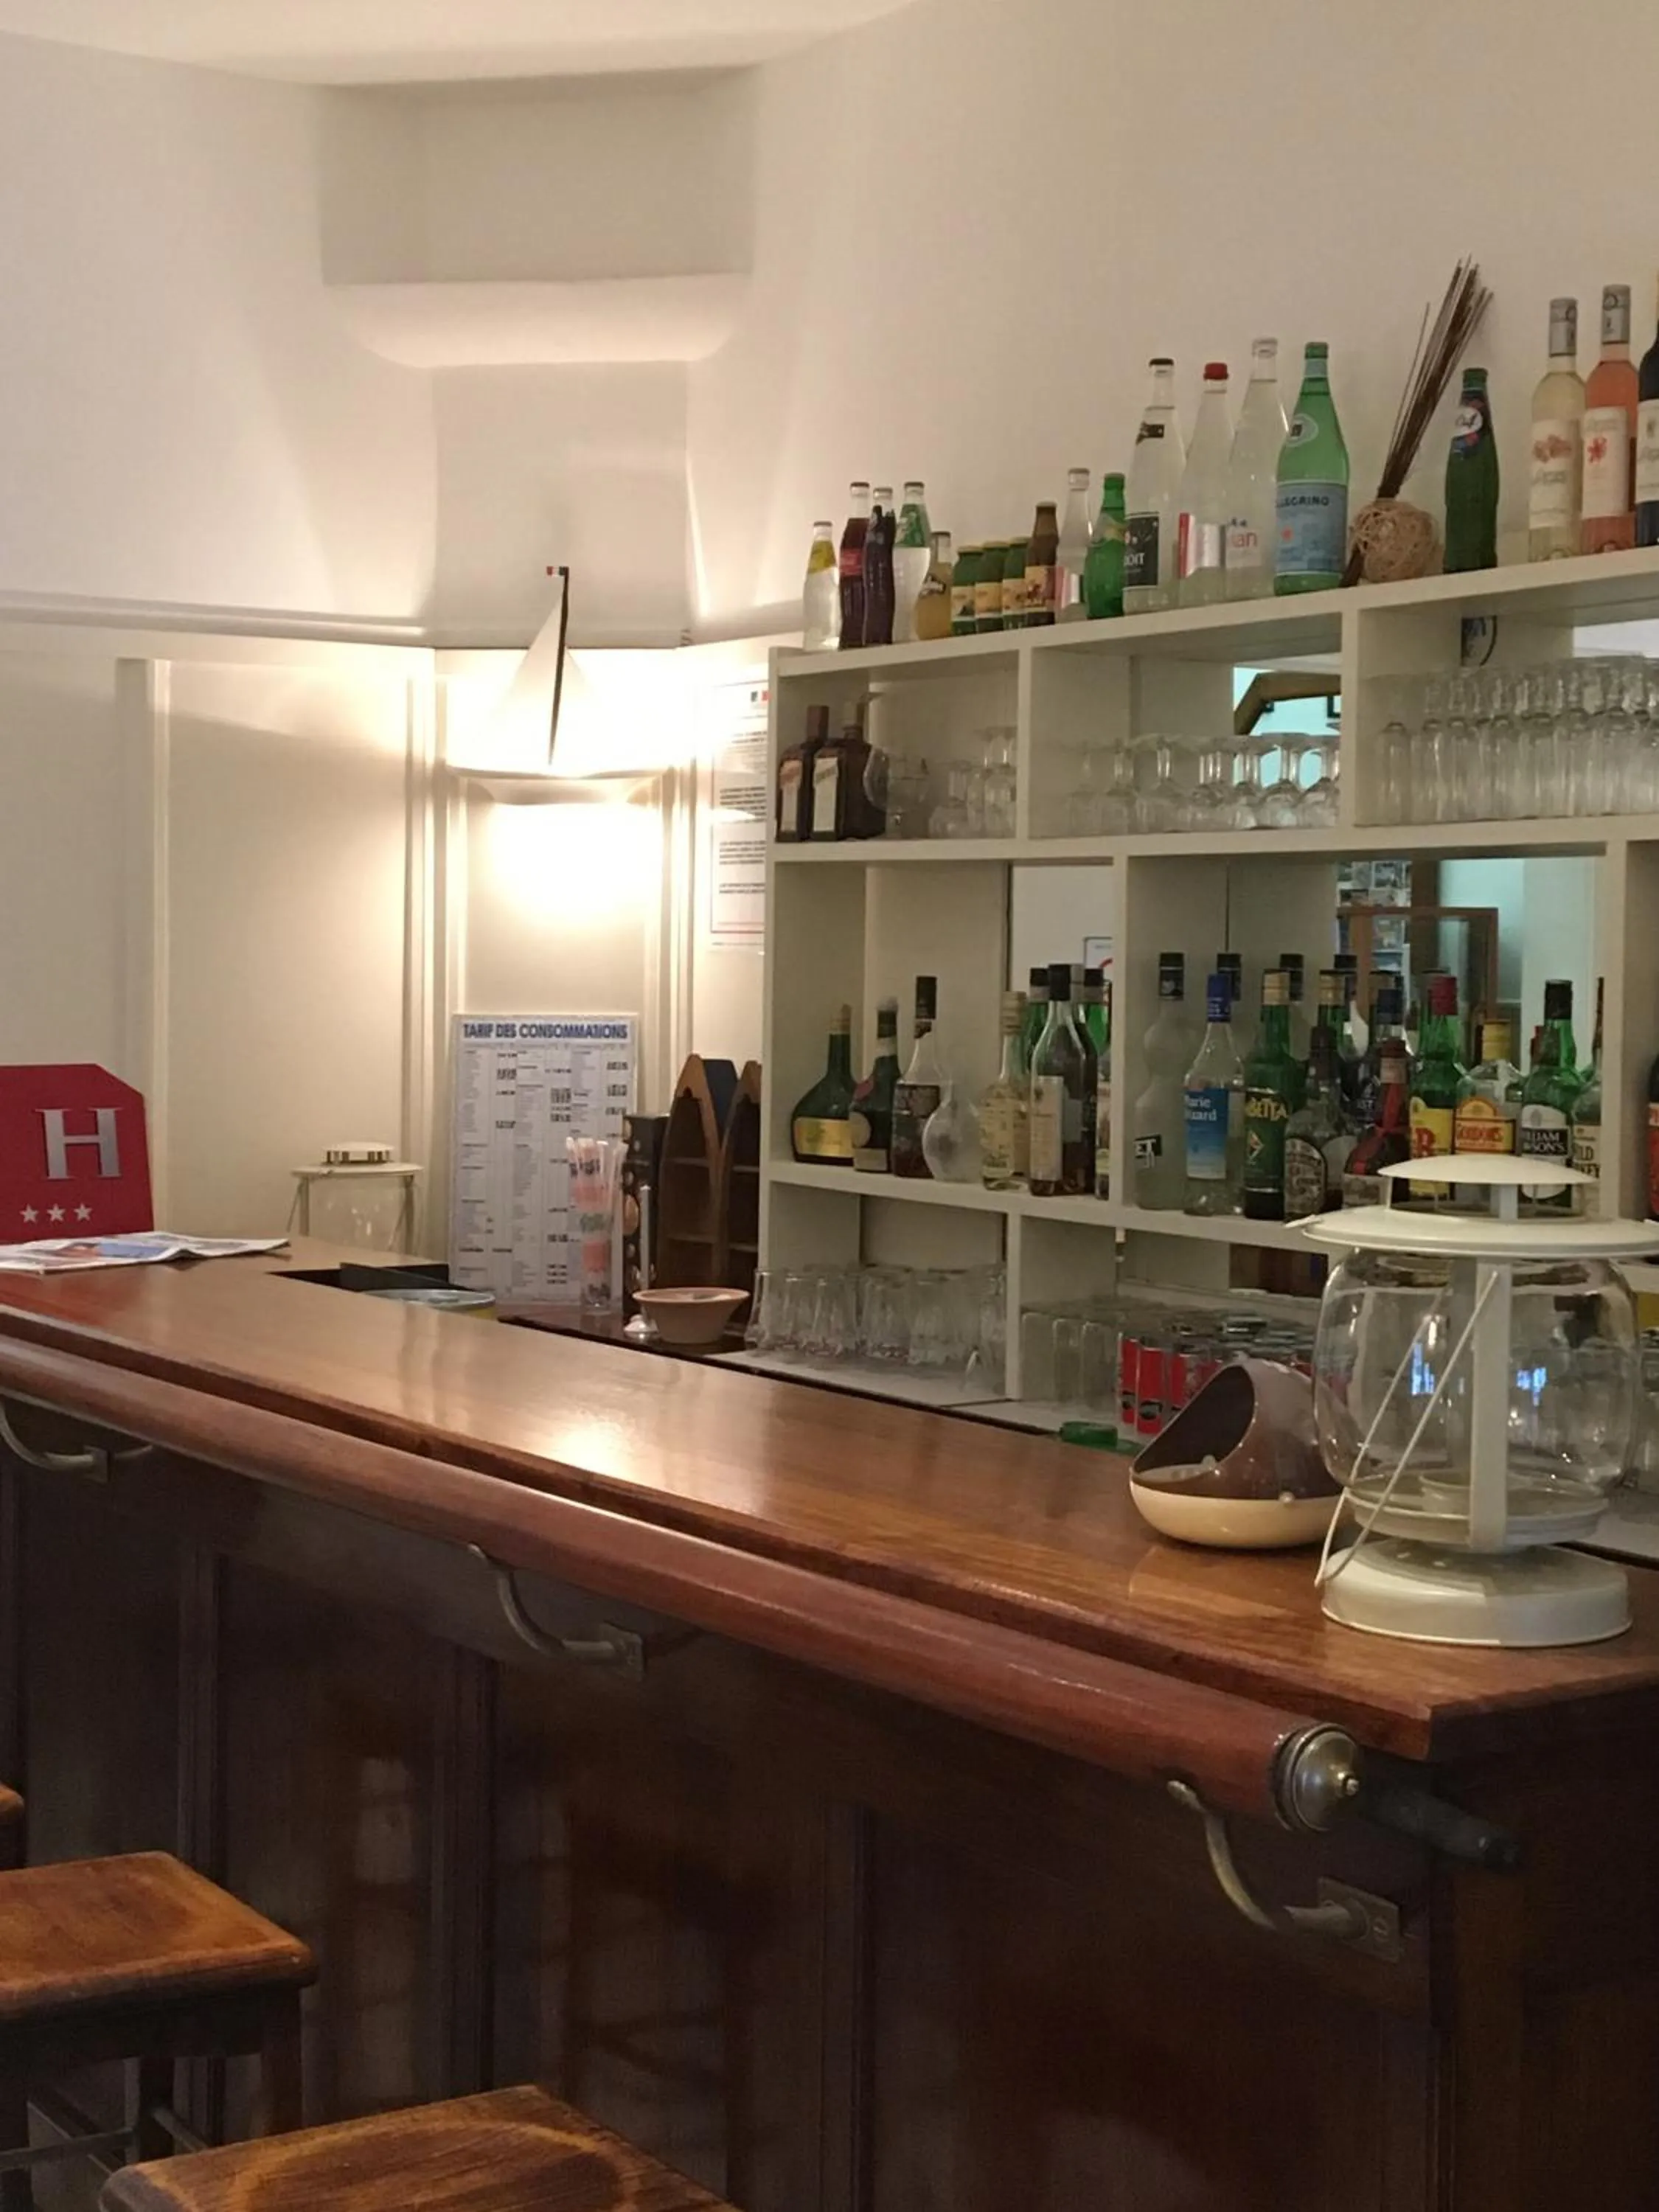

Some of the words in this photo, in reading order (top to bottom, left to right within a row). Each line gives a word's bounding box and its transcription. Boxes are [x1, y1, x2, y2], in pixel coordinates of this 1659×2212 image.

[463, 1023, 493, 1039] TARIF
[495, 1023, 517, 1039] DES
[519, 1023, 628, 1039] CONSOMMATIONS
[35, 1107, 122, 1179] H
